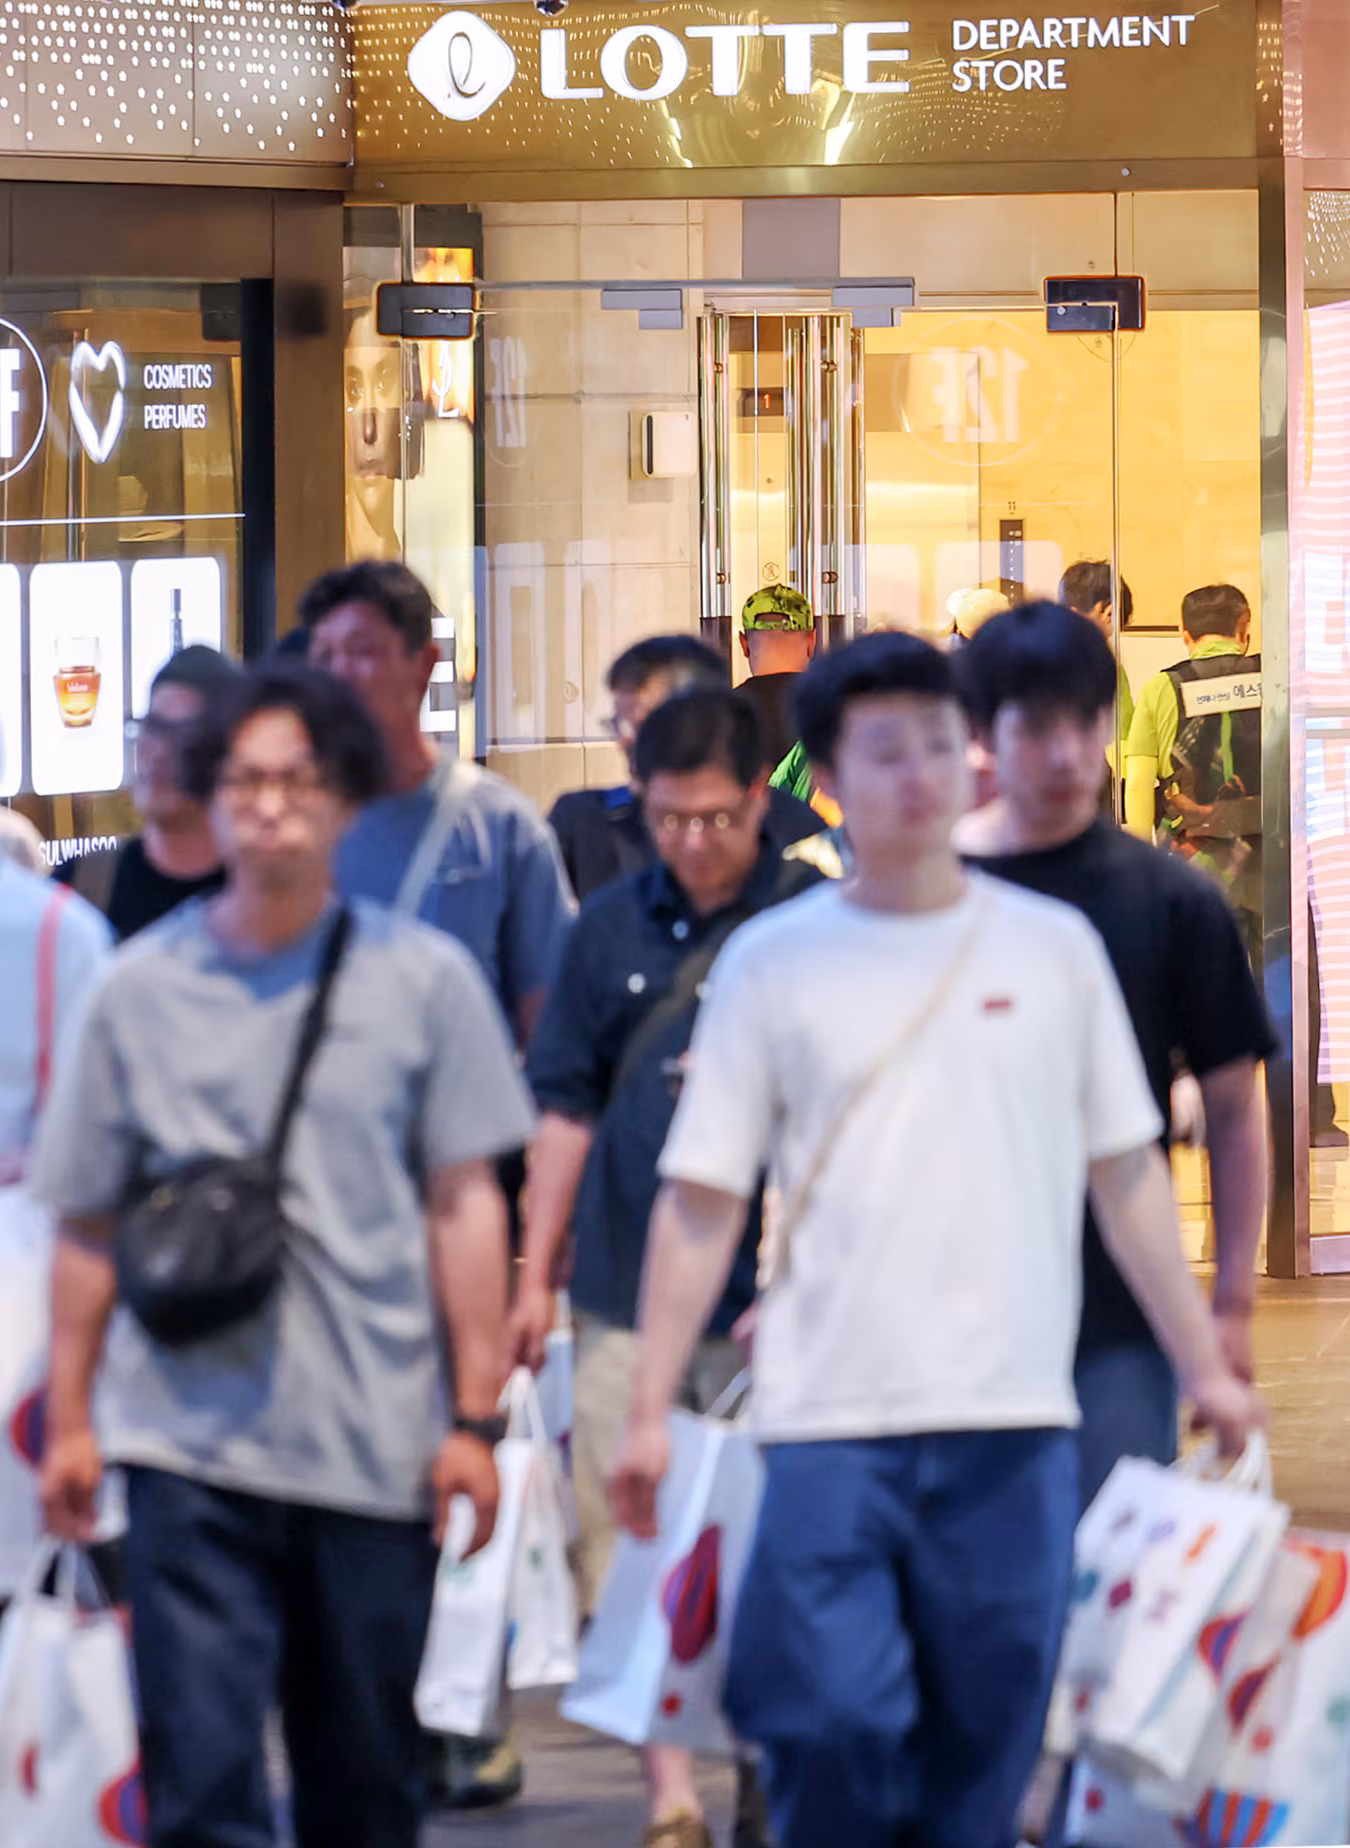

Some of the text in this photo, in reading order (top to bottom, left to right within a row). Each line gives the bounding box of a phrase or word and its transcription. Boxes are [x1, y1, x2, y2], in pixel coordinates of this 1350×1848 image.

[952, 15, 1195, 51] DEPARTMENT
[540, 20, 911, 101] LOTTE
[952, 58, 1067, 92] STORE
[143, 364, 212, 389] COSMETICS
[143, 404, 207, 429] PERFUMES
